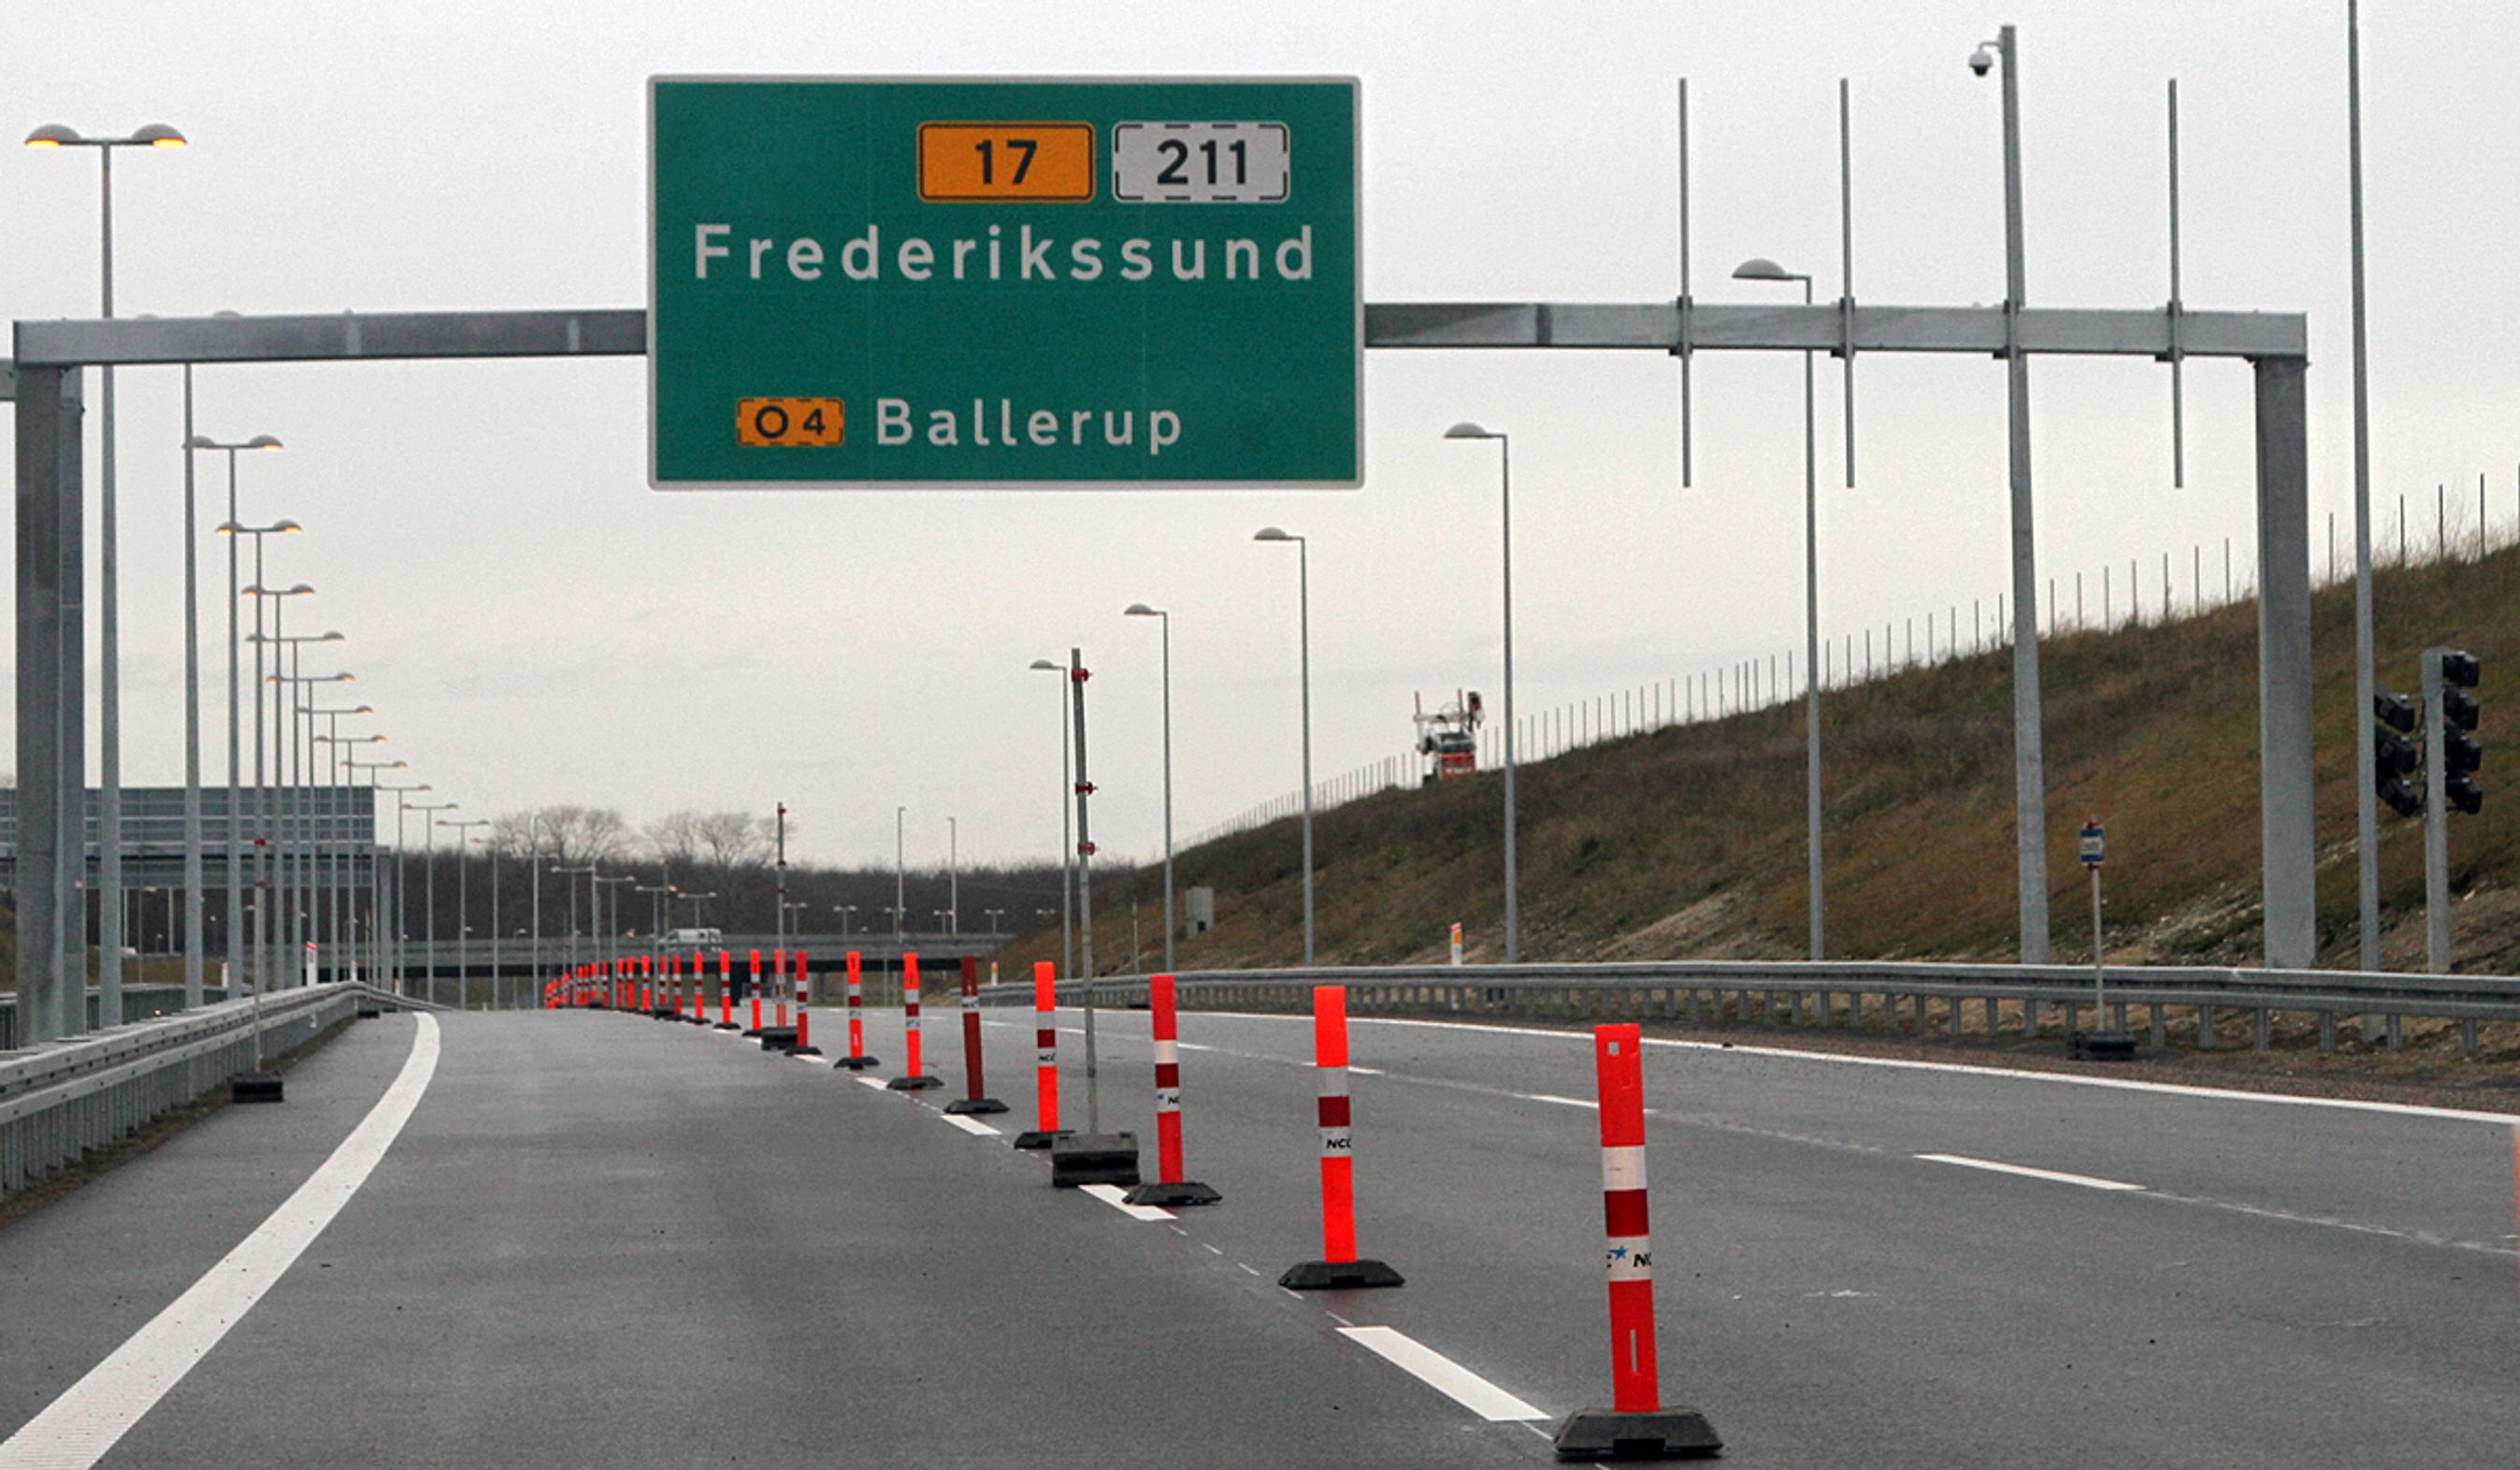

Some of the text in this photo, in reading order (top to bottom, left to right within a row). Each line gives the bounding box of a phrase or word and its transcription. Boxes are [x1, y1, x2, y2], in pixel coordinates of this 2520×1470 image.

[975, 139, 1039, 185] 17
[1156, 139, 1248, 186] 211
[695, 224, 1313, 281] Frederikssund
[876, 398, 1182, 454] Ballerup
